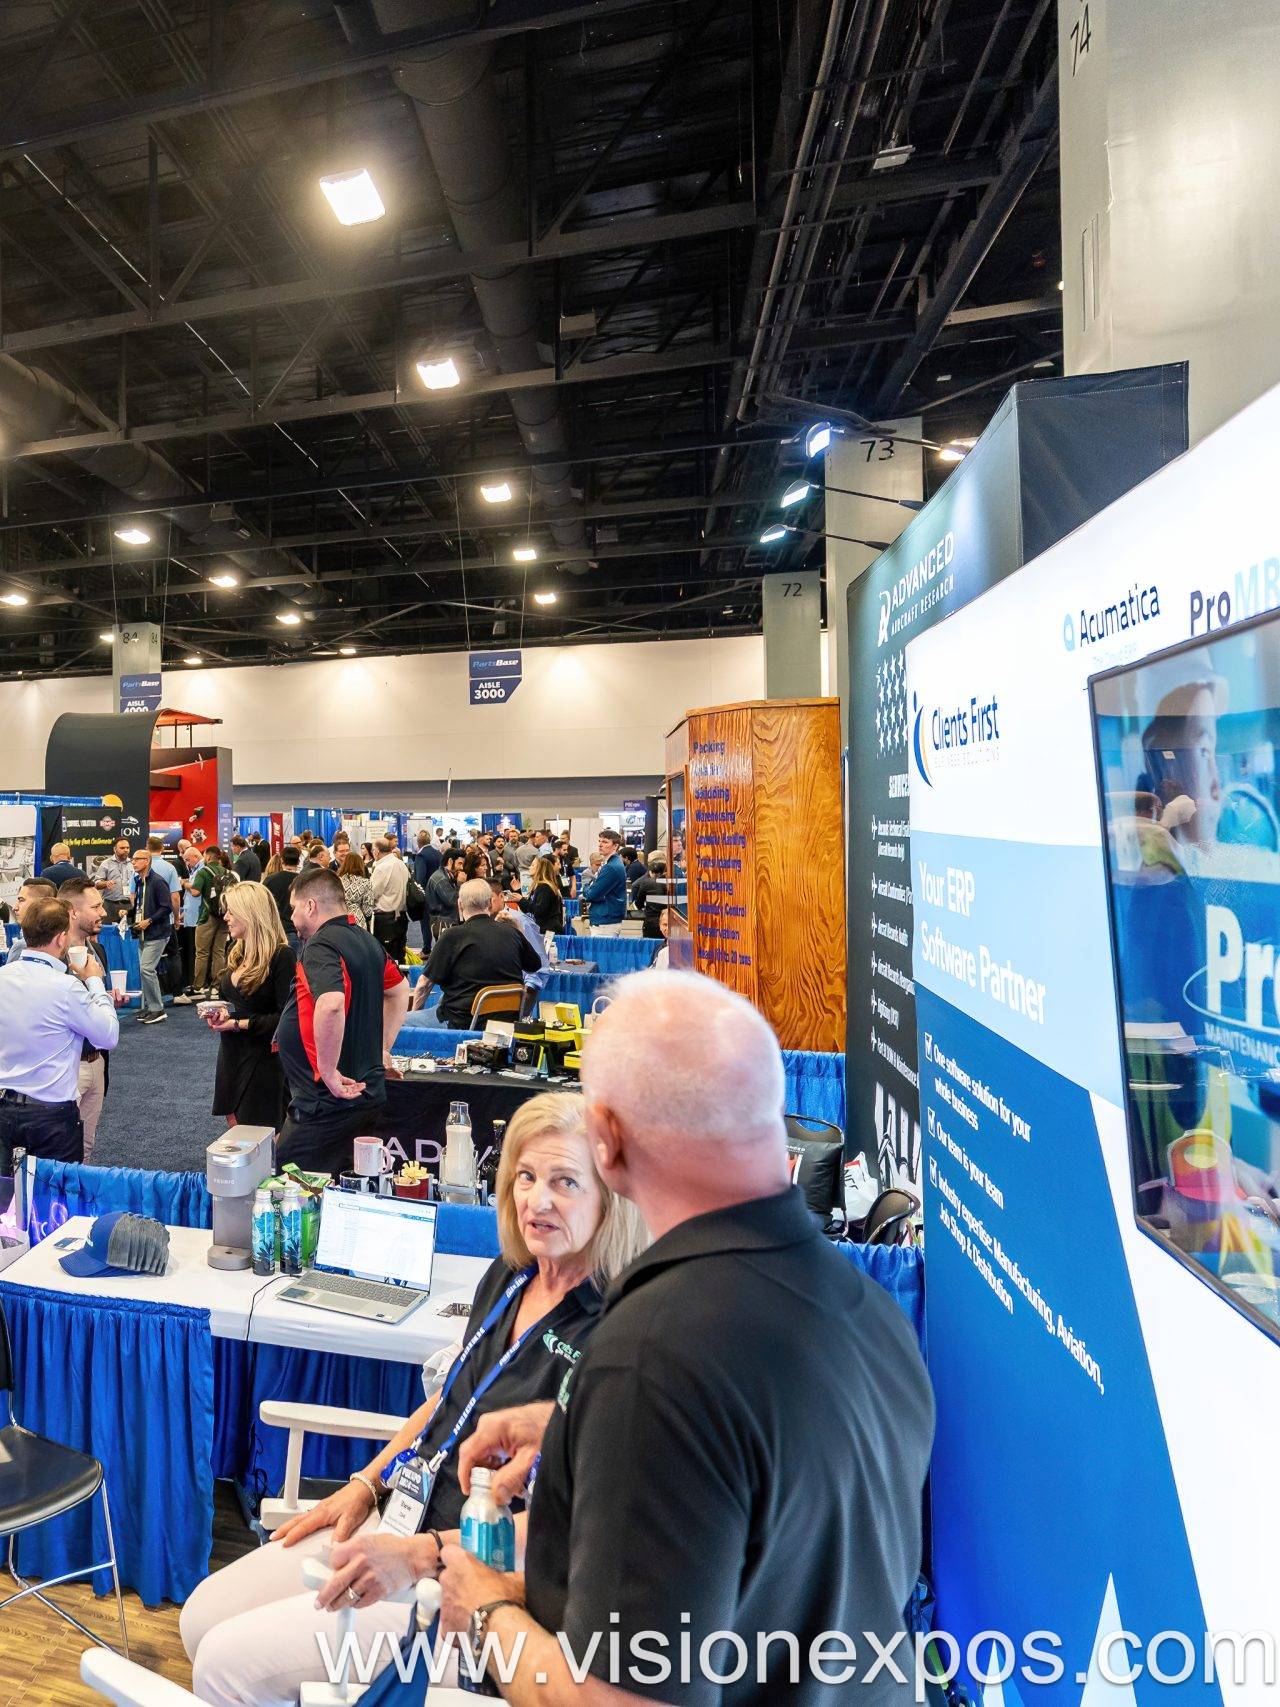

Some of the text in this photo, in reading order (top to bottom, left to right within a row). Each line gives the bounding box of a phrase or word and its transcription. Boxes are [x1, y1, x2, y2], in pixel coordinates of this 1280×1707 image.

[860, 439, 895, 463] 73
[782, 582, 802, 597] 72
[890, 531, 954, 607] ADVANCED
[890, 573, 954, 637] AIRCRAFT RESEARCH
[1080, 583, 1160, 648] Acumatica
[1190, 557, 1280, 637] ProMR
[122, 632, 139, 645] 84
[472, 659, 518, 668] PartsBase
[122, 680, 160, 688] PartsBase
[474, 689, 505, 700] 3000
[693, 740, 726, 755] Packing
[932, 694, 1000, 751] Clients First
[695, 809, 736, 825] Warehousing
[695, 877, 734, 896] Trucking
[724, 904, 747, 918] Control
[919, 861, 945, 908] Your
[946, 867, 975, 917] ERP
[920, 920, 1046, 1025] Software Partner
[1206, 904, 1280, 1029] Pr
[1204, 1021, 1280, 1066] MAINTENANC
[933, 1043, 1032, 1142] One software solution for your
[935, 1077, 979, 1131] whole business
[936, 1121, 1004, 1210] Our team is your team
[938, 1170, 962, 1217] Industry
[993, 1236, 1056, 1336] Manufacturing,
[1057, 1314, 1105, 1396] Aviation,
[940, 1202, 1014, 1315] Job Shop & Distribution
